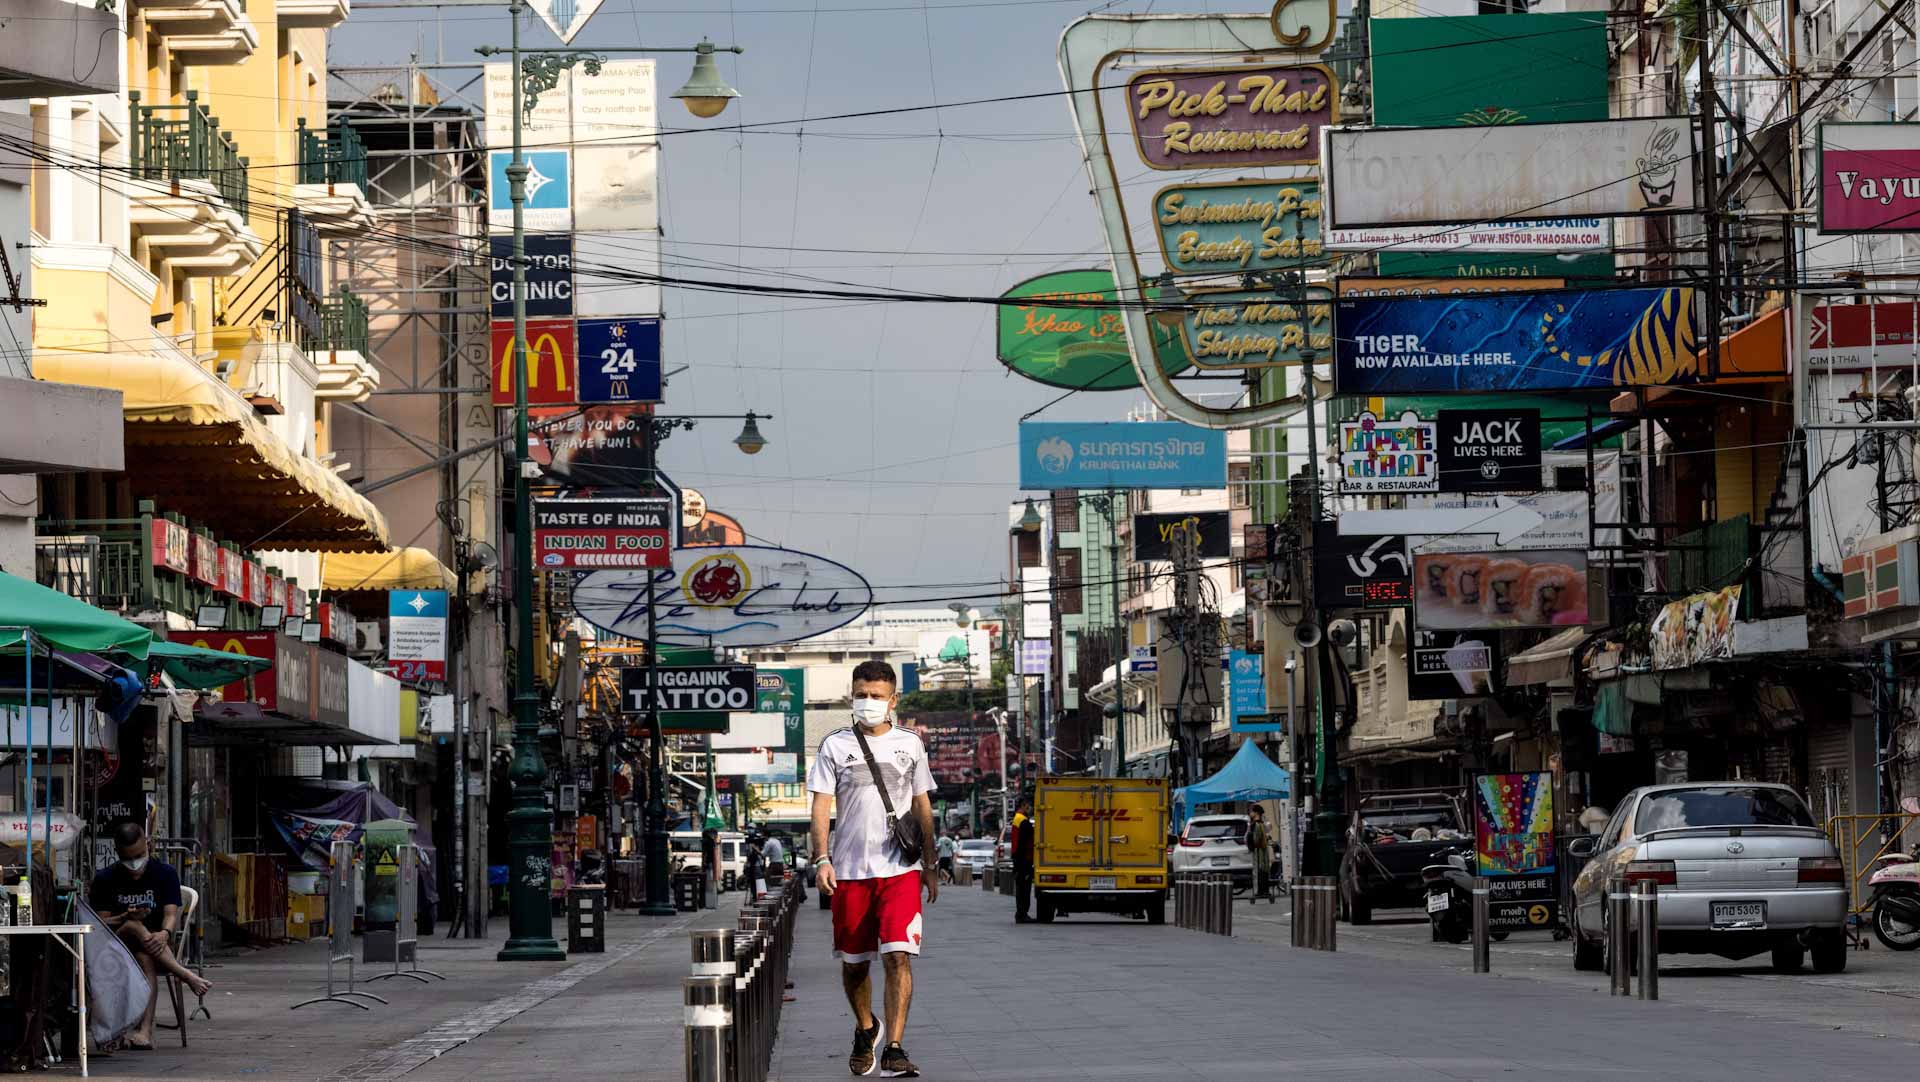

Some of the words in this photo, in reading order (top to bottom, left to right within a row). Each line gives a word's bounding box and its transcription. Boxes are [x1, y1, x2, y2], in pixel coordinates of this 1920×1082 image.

[1137, 75, 1328, 120] Pick-Thai
[1163, 121, 1310, 156] Restaurant
[1535, 218, 1600, 228] BOOKING
[1177, 230, 1254, 268] Beauty
[1015, 312, 1087, 336] Khao
[1196, 329, 1279, 361] Shopping
[1355, 334, 1427, 354] TIGER.
[601, 348, 637, 373] 24
[1355, 356, 1388, 369] NOW
[1392, 354, 1471, 369] AVAILABLE
[1474, 352, 1517, 366] HERE.
[1838, 353, 1860, 363] THAI
[610, 373, 629, 381] hours
[588, 420, 612, 431] YOU
[1453, 420, 1523, 445] JACK
[561, 438, 594, 450] HAVE
[1454, 446, 1487, 457] LIVES
[1491, 445, 1523, 456] HERE
[1079, 461, 1146, 470] KRUNGTHAI
[1147, 461, 1180, 470] BANK
[1343, 482, 1362, 491] BAR
[1366, 482, 1373, 490] &
[1377, 481, 1436, 490] RESTAURANT
[539, 513, 588, 525] TASTE
[592, 513, 613, 525] OF
[617, 513, 661, 526] INDIA
[544, 535, 606, 549] INDIAN
[615, 535, 665, 550] FOOD
[629, 687, 748, 709] TATTOO
[1072, 808, 1131, 822] DHL
[1489, 882, 1506, 891] JACK
[1506, 880, 1527, 890] LIVES
[1528, 879, 1547, 889] HERE
[1737, 904, 1761, 915] 5305
